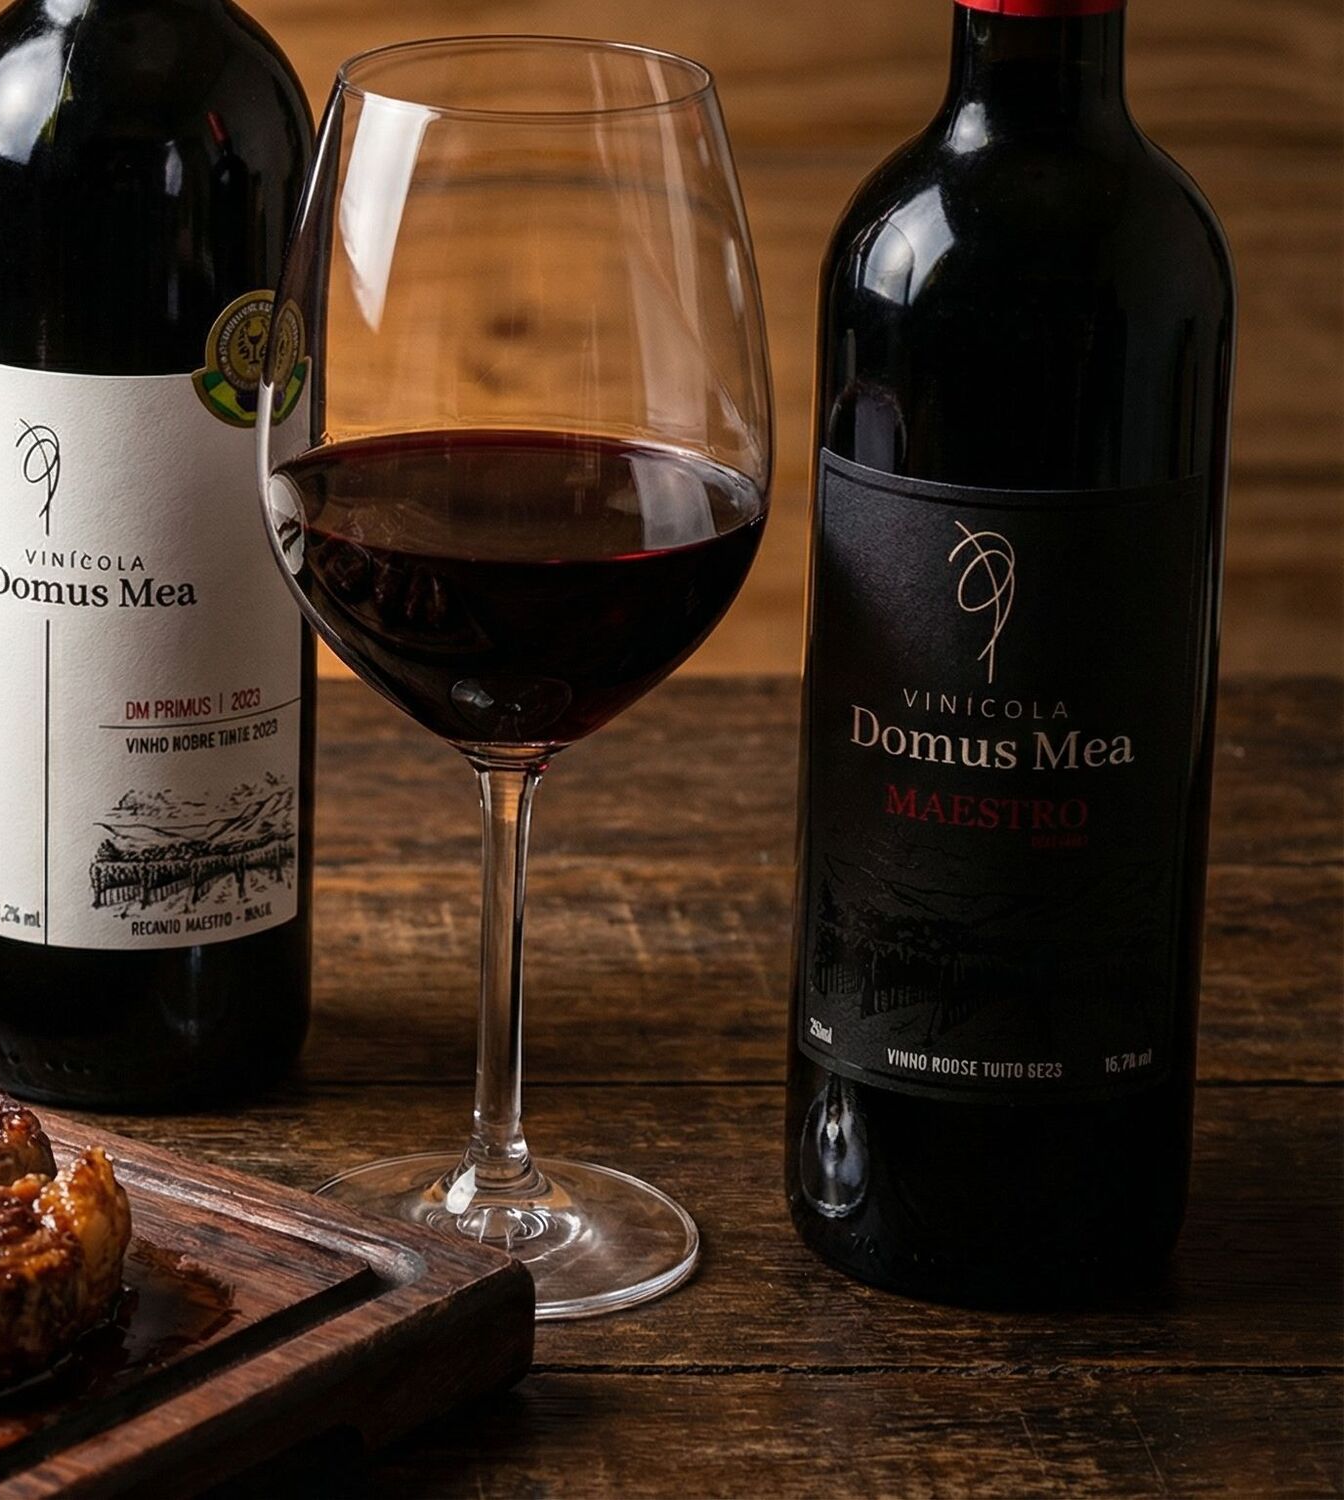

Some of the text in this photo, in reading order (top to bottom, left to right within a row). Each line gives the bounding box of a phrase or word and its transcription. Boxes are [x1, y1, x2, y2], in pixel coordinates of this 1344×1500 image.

[25, 549, 145, 572] VINÍCOLA
[118, 577, 198, 608] Mea
[125, 701, 150, 720] DM
[154, 696, 212, 719] PRIMUS
[231, 687, 261, 712] 2023
[903, 688, 1069, 720] VINÍCOLA
[125, 737, 169, 754] VINHO
[252, 718, 279, 740] 2023
[849, 704, 1135, 771] Domus Mea
[882, 782, 1090, 831] MAESTRO
